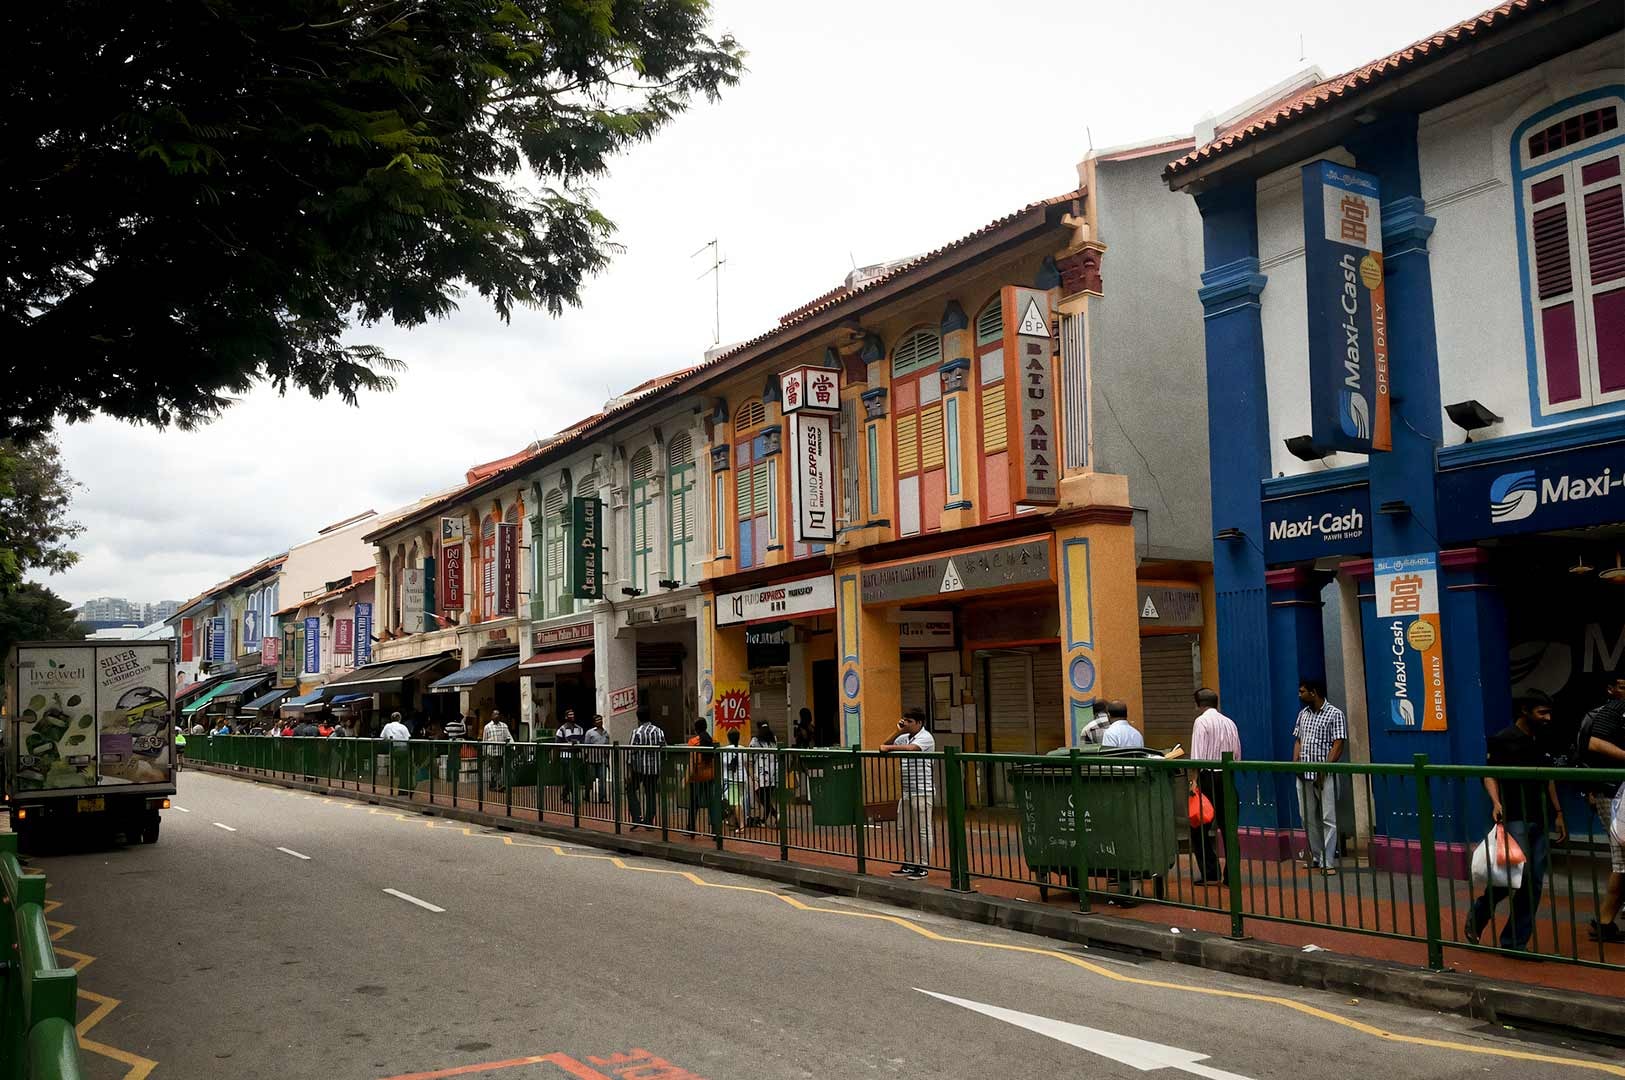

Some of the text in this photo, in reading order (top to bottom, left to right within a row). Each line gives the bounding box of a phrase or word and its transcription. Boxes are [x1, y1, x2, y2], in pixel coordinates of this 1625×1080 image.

[1340, 253, 1361, 389] Maxi-Cash
[1376, 303, 1387, 395] OPEN DAILY
[1026, 343, 1045, 400] BATU
[785, 377, 800, 406] 當
[812, 374, 834, 405] 當
[1029, 408, 1049, 481] PAHAT
[1541, 467, 1625, 505] Maxi-
[1269, 508, 1363, 541] Maxi-Cash
[1323, 530, 1362, 542] PAWN SHOP
[100, 649, 137, 670] SILVER
[104, 659, 140, 678] CREEK
[1390, 621, 1407, 698] Maxi-Cash
[612, 690, 635, 709] SALE
[1432, 655, 1443, 720] OPEN DAILY
[720, 697, 746, 719] 1%
